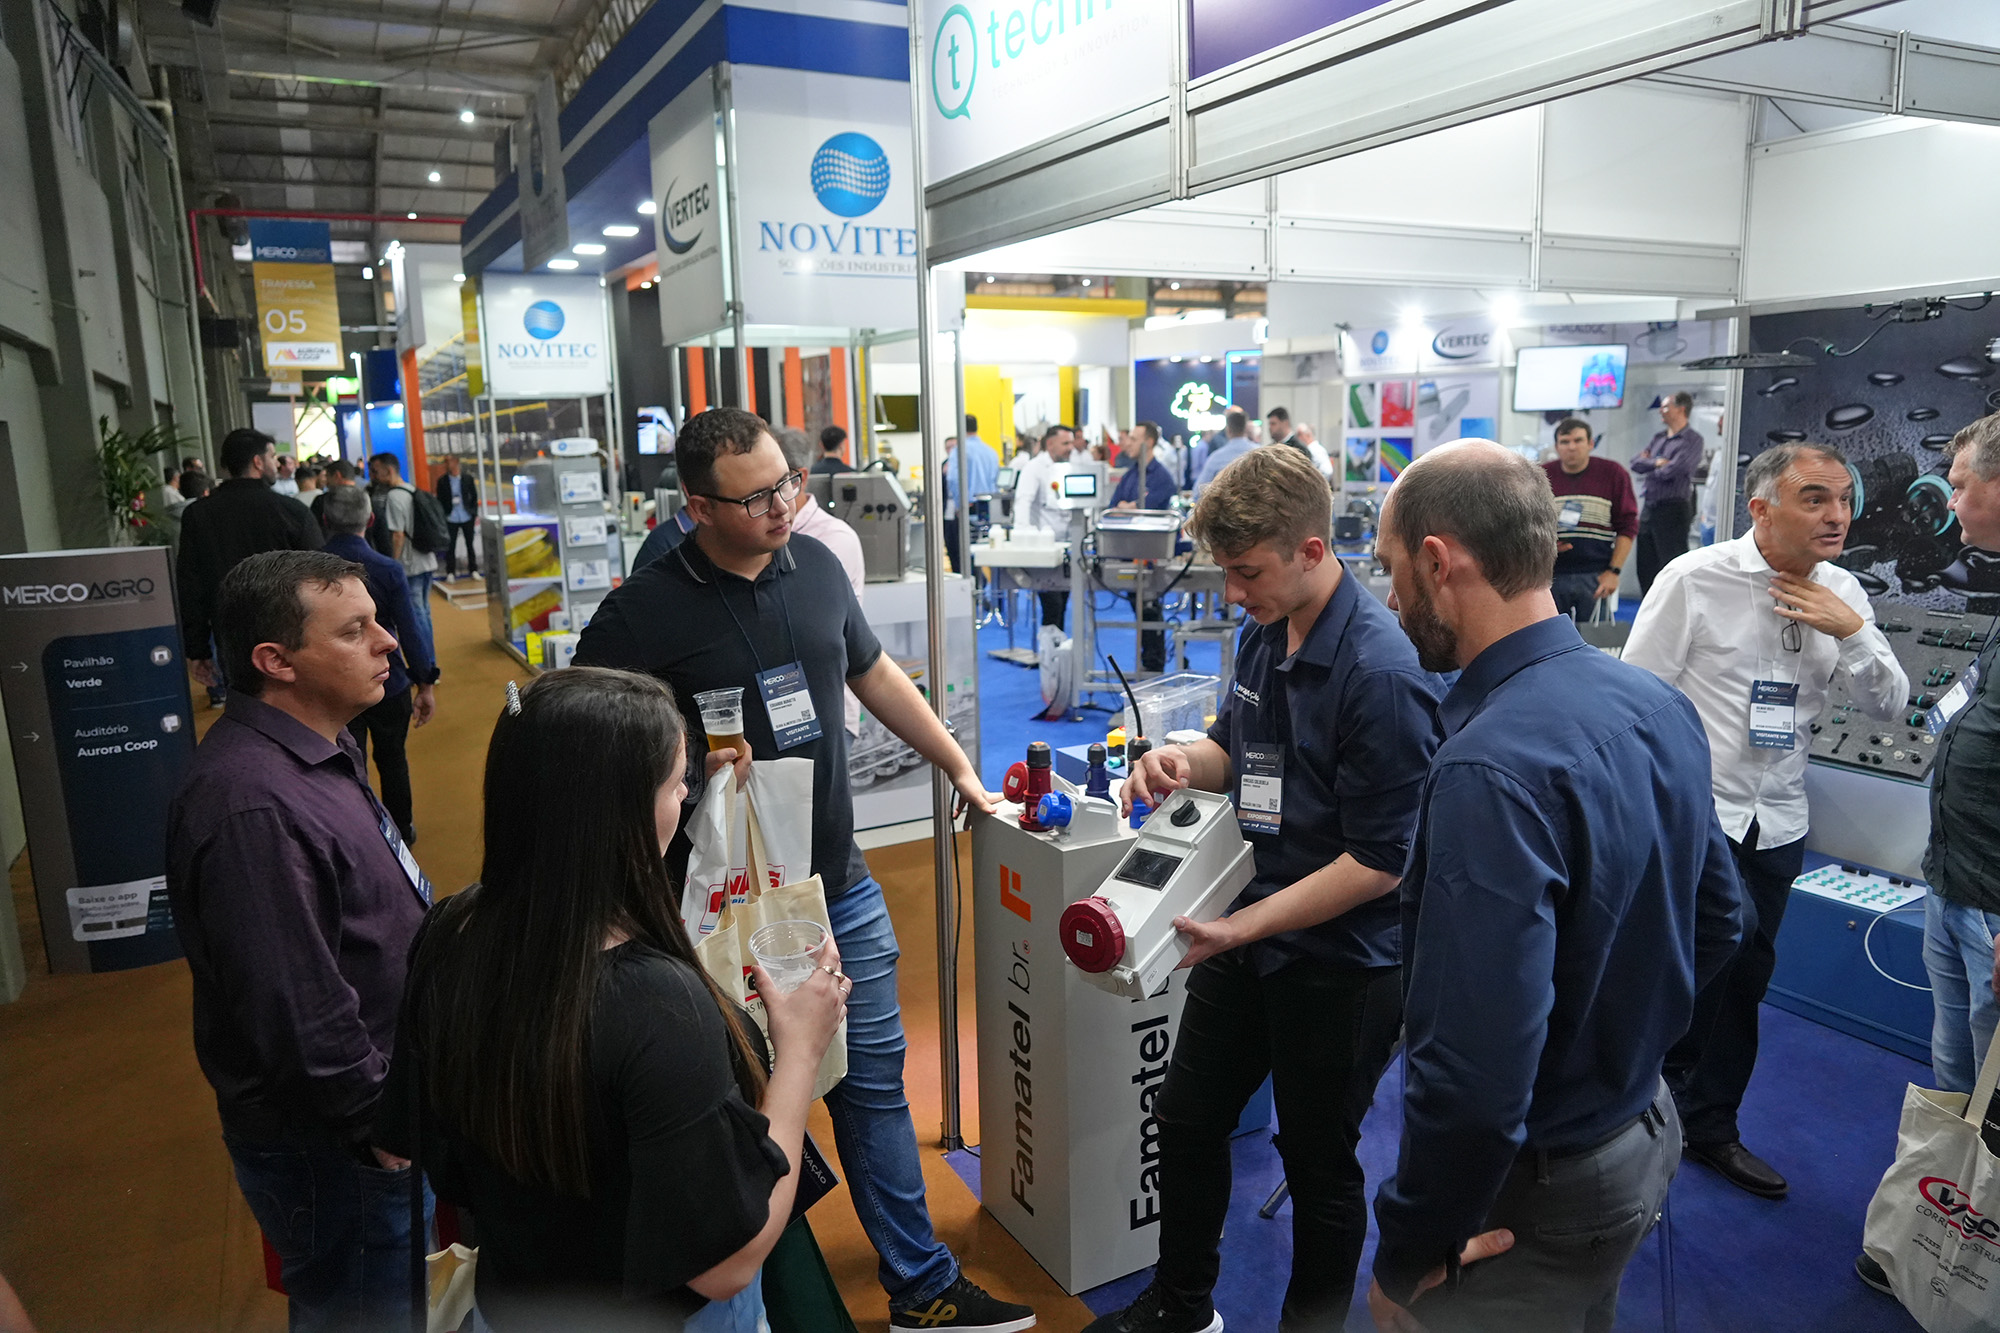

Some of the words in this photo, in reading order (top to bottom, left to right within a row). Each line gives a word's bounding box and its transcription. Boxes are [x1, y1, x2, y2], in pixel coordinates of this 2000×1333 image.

[1074, 14, 1150, 60] INNOVATION
[667, 182, 710, 230] VERTEC
[758, 220, 917, 256] NOVITE
[848, 259, 917, 274] INDUSTRI
[260, 279, 316, 290] TRAVESSA
[265, 309, 307, 335] 05
[498, 340, 598, 359] NOVITEC
[1440, 333, 1490, 349] VERTEC
[2, 577, 155, 605] MERCOAGRO
[63, 656, 115, 668] Pavilhão
[66, 677, 103, 689] Verde
[74, 724, 129, 738] Auditório
[77, 744, 122, 758] Aurora
[124, 739, 158, 752] Coop
[78, 895, 106, 905] Baixe
[117, 892, 138, 901] app
[1008, 1000, 1035, 1217] Famatel
[1130, 1014, 1170, 1232] Famatel
